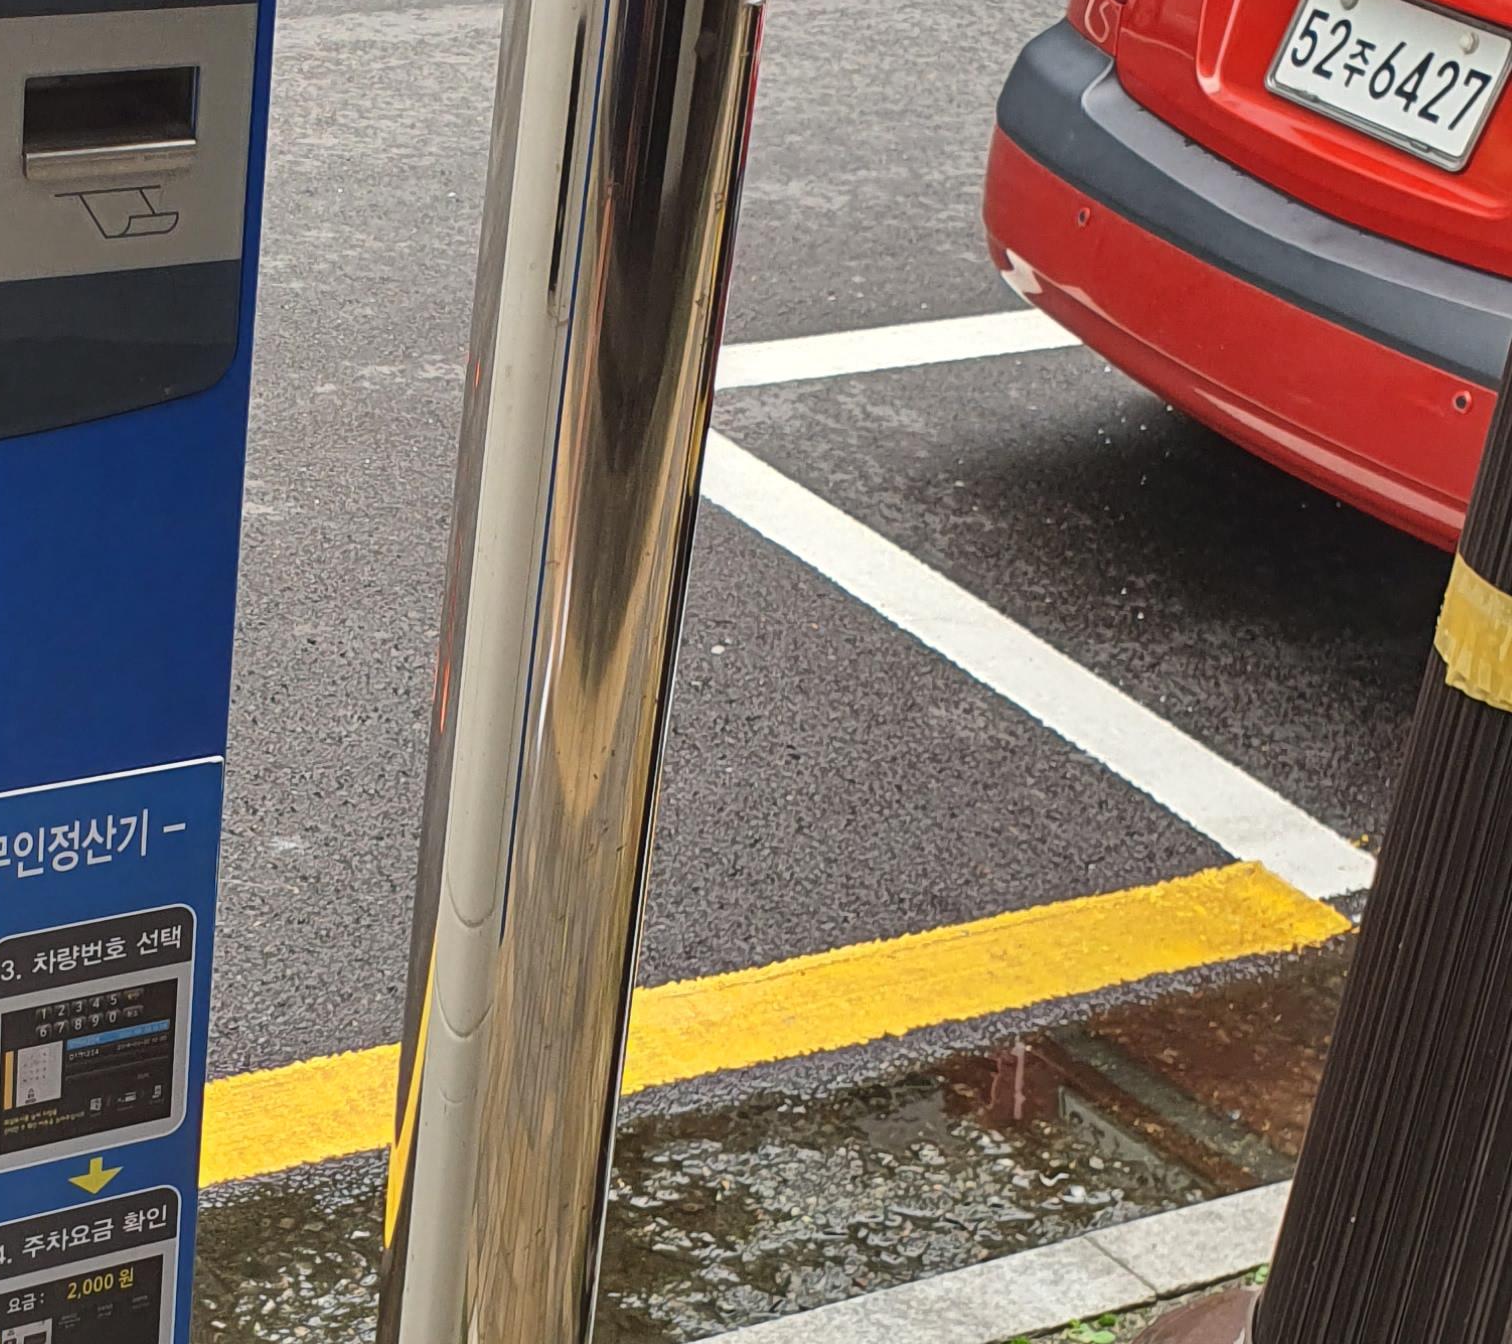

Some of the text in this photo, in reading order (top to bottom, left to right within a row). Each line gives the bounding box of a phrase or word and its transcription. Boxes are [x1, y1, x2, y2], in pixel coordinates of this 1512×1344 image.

[1292, 9, 1493, 131] 52주6427
[0, 924, 183, 981] 3. 차량번호 선택
[22, 1218, 114, 1258] 주차요금
[122, 1204, 167, 1233] 확인
[66, 1272, 115, 1300] 2,000
[119, 1267, 135, 1290] 원
